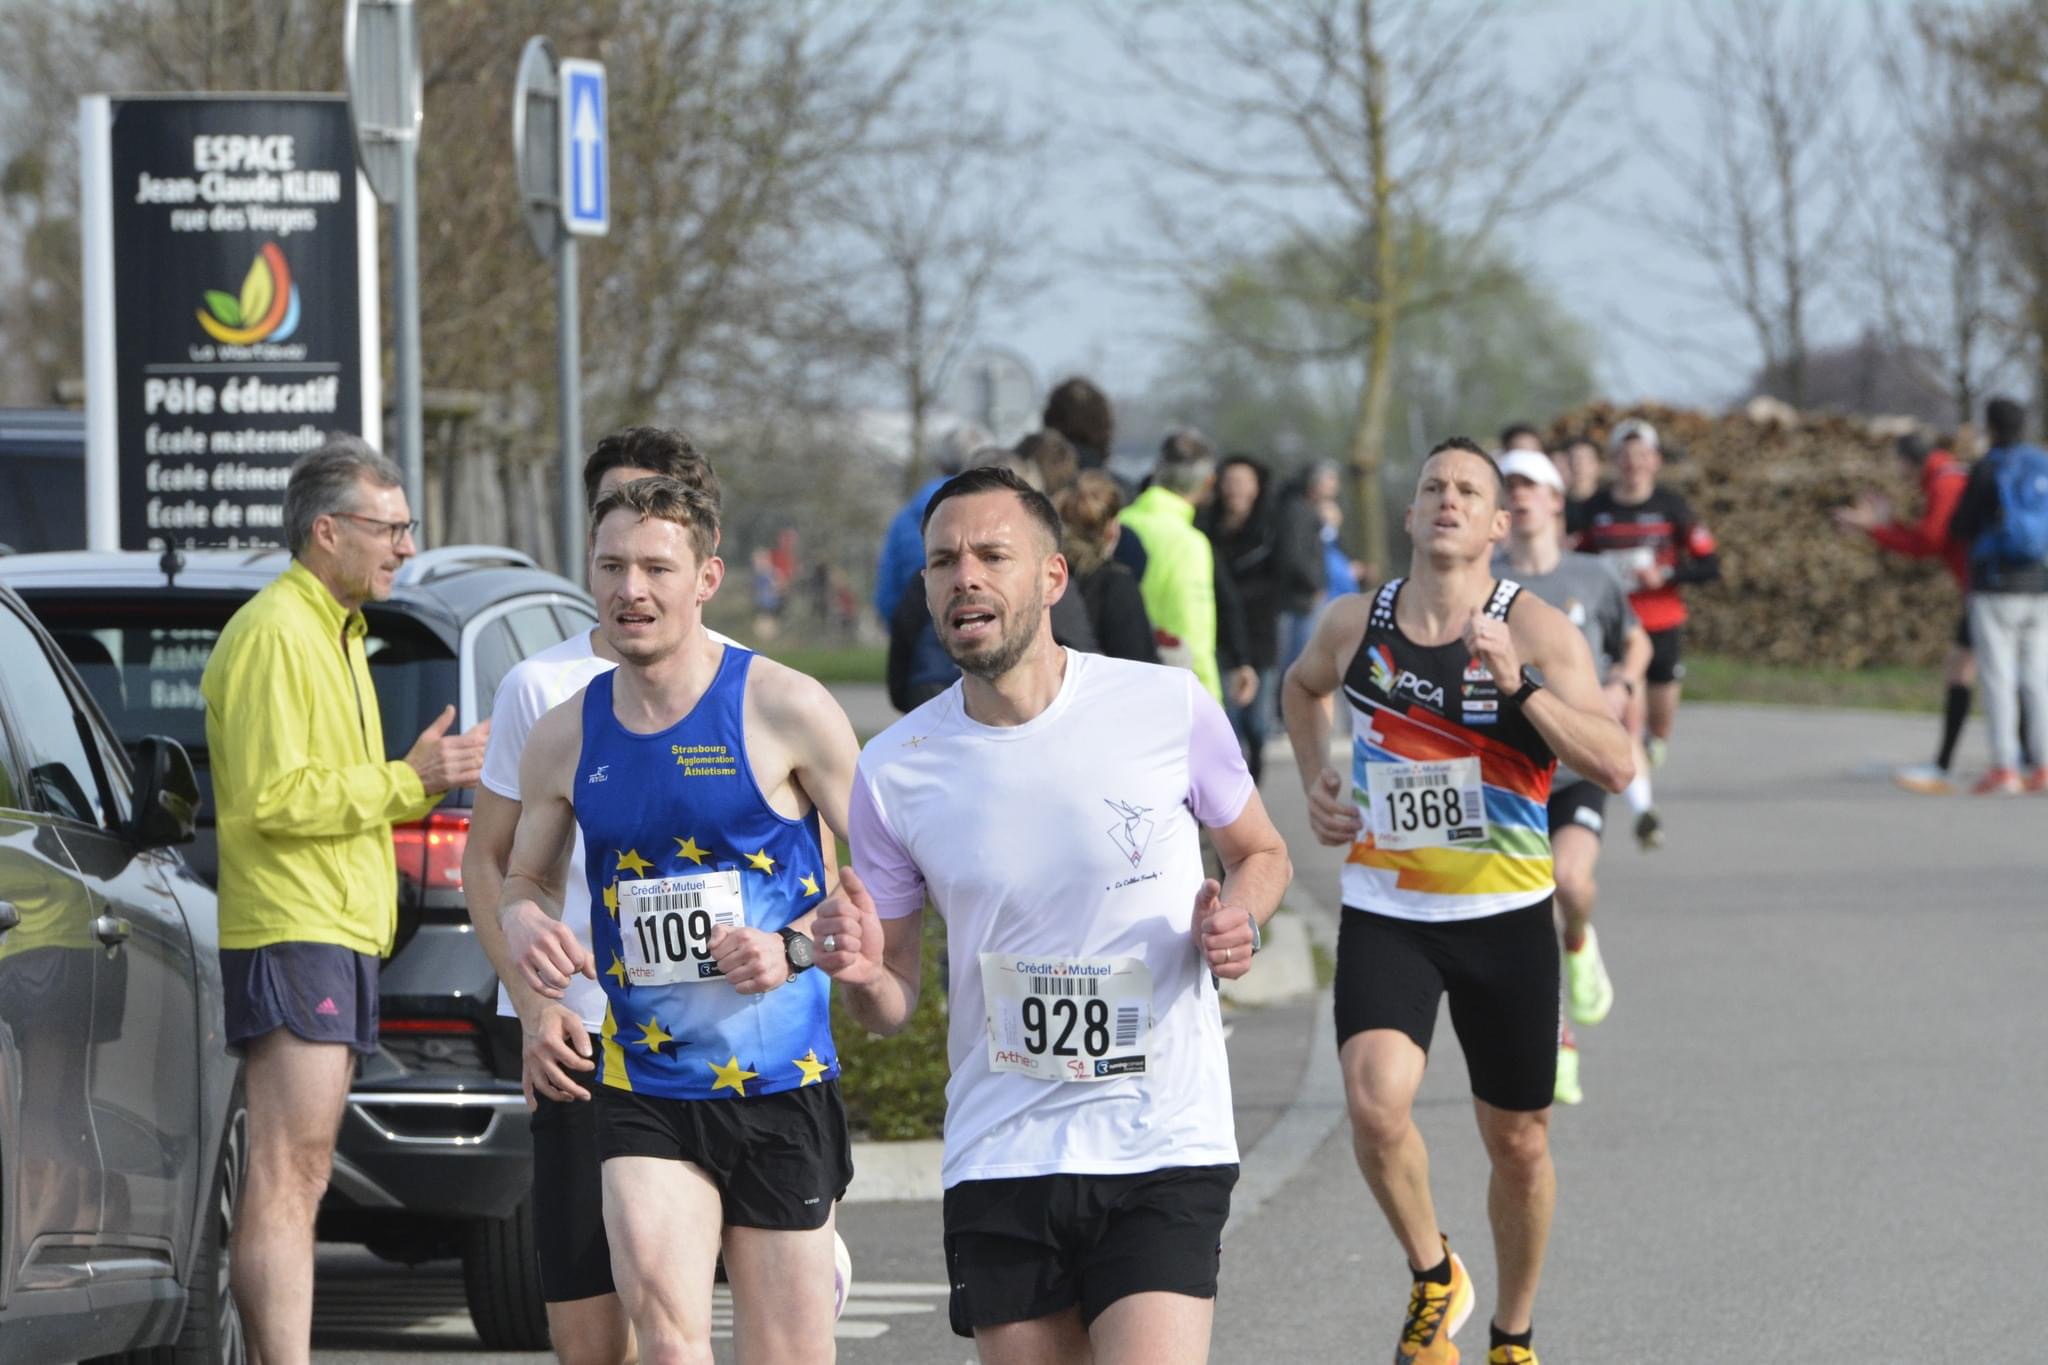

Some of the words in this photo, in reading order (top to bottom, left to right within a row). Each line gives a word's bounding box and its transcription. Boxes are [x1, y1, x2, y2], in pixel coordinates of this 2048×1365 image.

[194, 135, 295, 171] ESPACE
[136, 171, 282, 204] Jean-Claude
[282, 171, 341, 202] KLEIN
[170, 209, 208, 231] rue
[208, 203, 246, 231] des
[145, 377, 215, 414] Pôle
[220, 376, 338, 413] éducatif
[145, 422, 208, 455] École
[210, 424, 327, 454] maternelle
[146, 460, 209, 492] École
[147, 496, 210, 528] École
[211, 499, 243, 528] de
[1397, 671, 1444, 708] PCA
[671, 744, 727, 755] Strasbourg
[676, 755, 735, 767] Agglomération
[683, 766, 737, 777] Athlétisme
[1386, 788, 1463, 832] 1368
[631, 885, 661, 896] Crédit
[671, 880, 706, 892] Mutuel
[634, 910, 712, 964] 1109
[1016, 961, 1053, 975] Crédit
[1068, 964, 1112, 976] Mutuel
[1022, 997, 1110, 1057] 928
